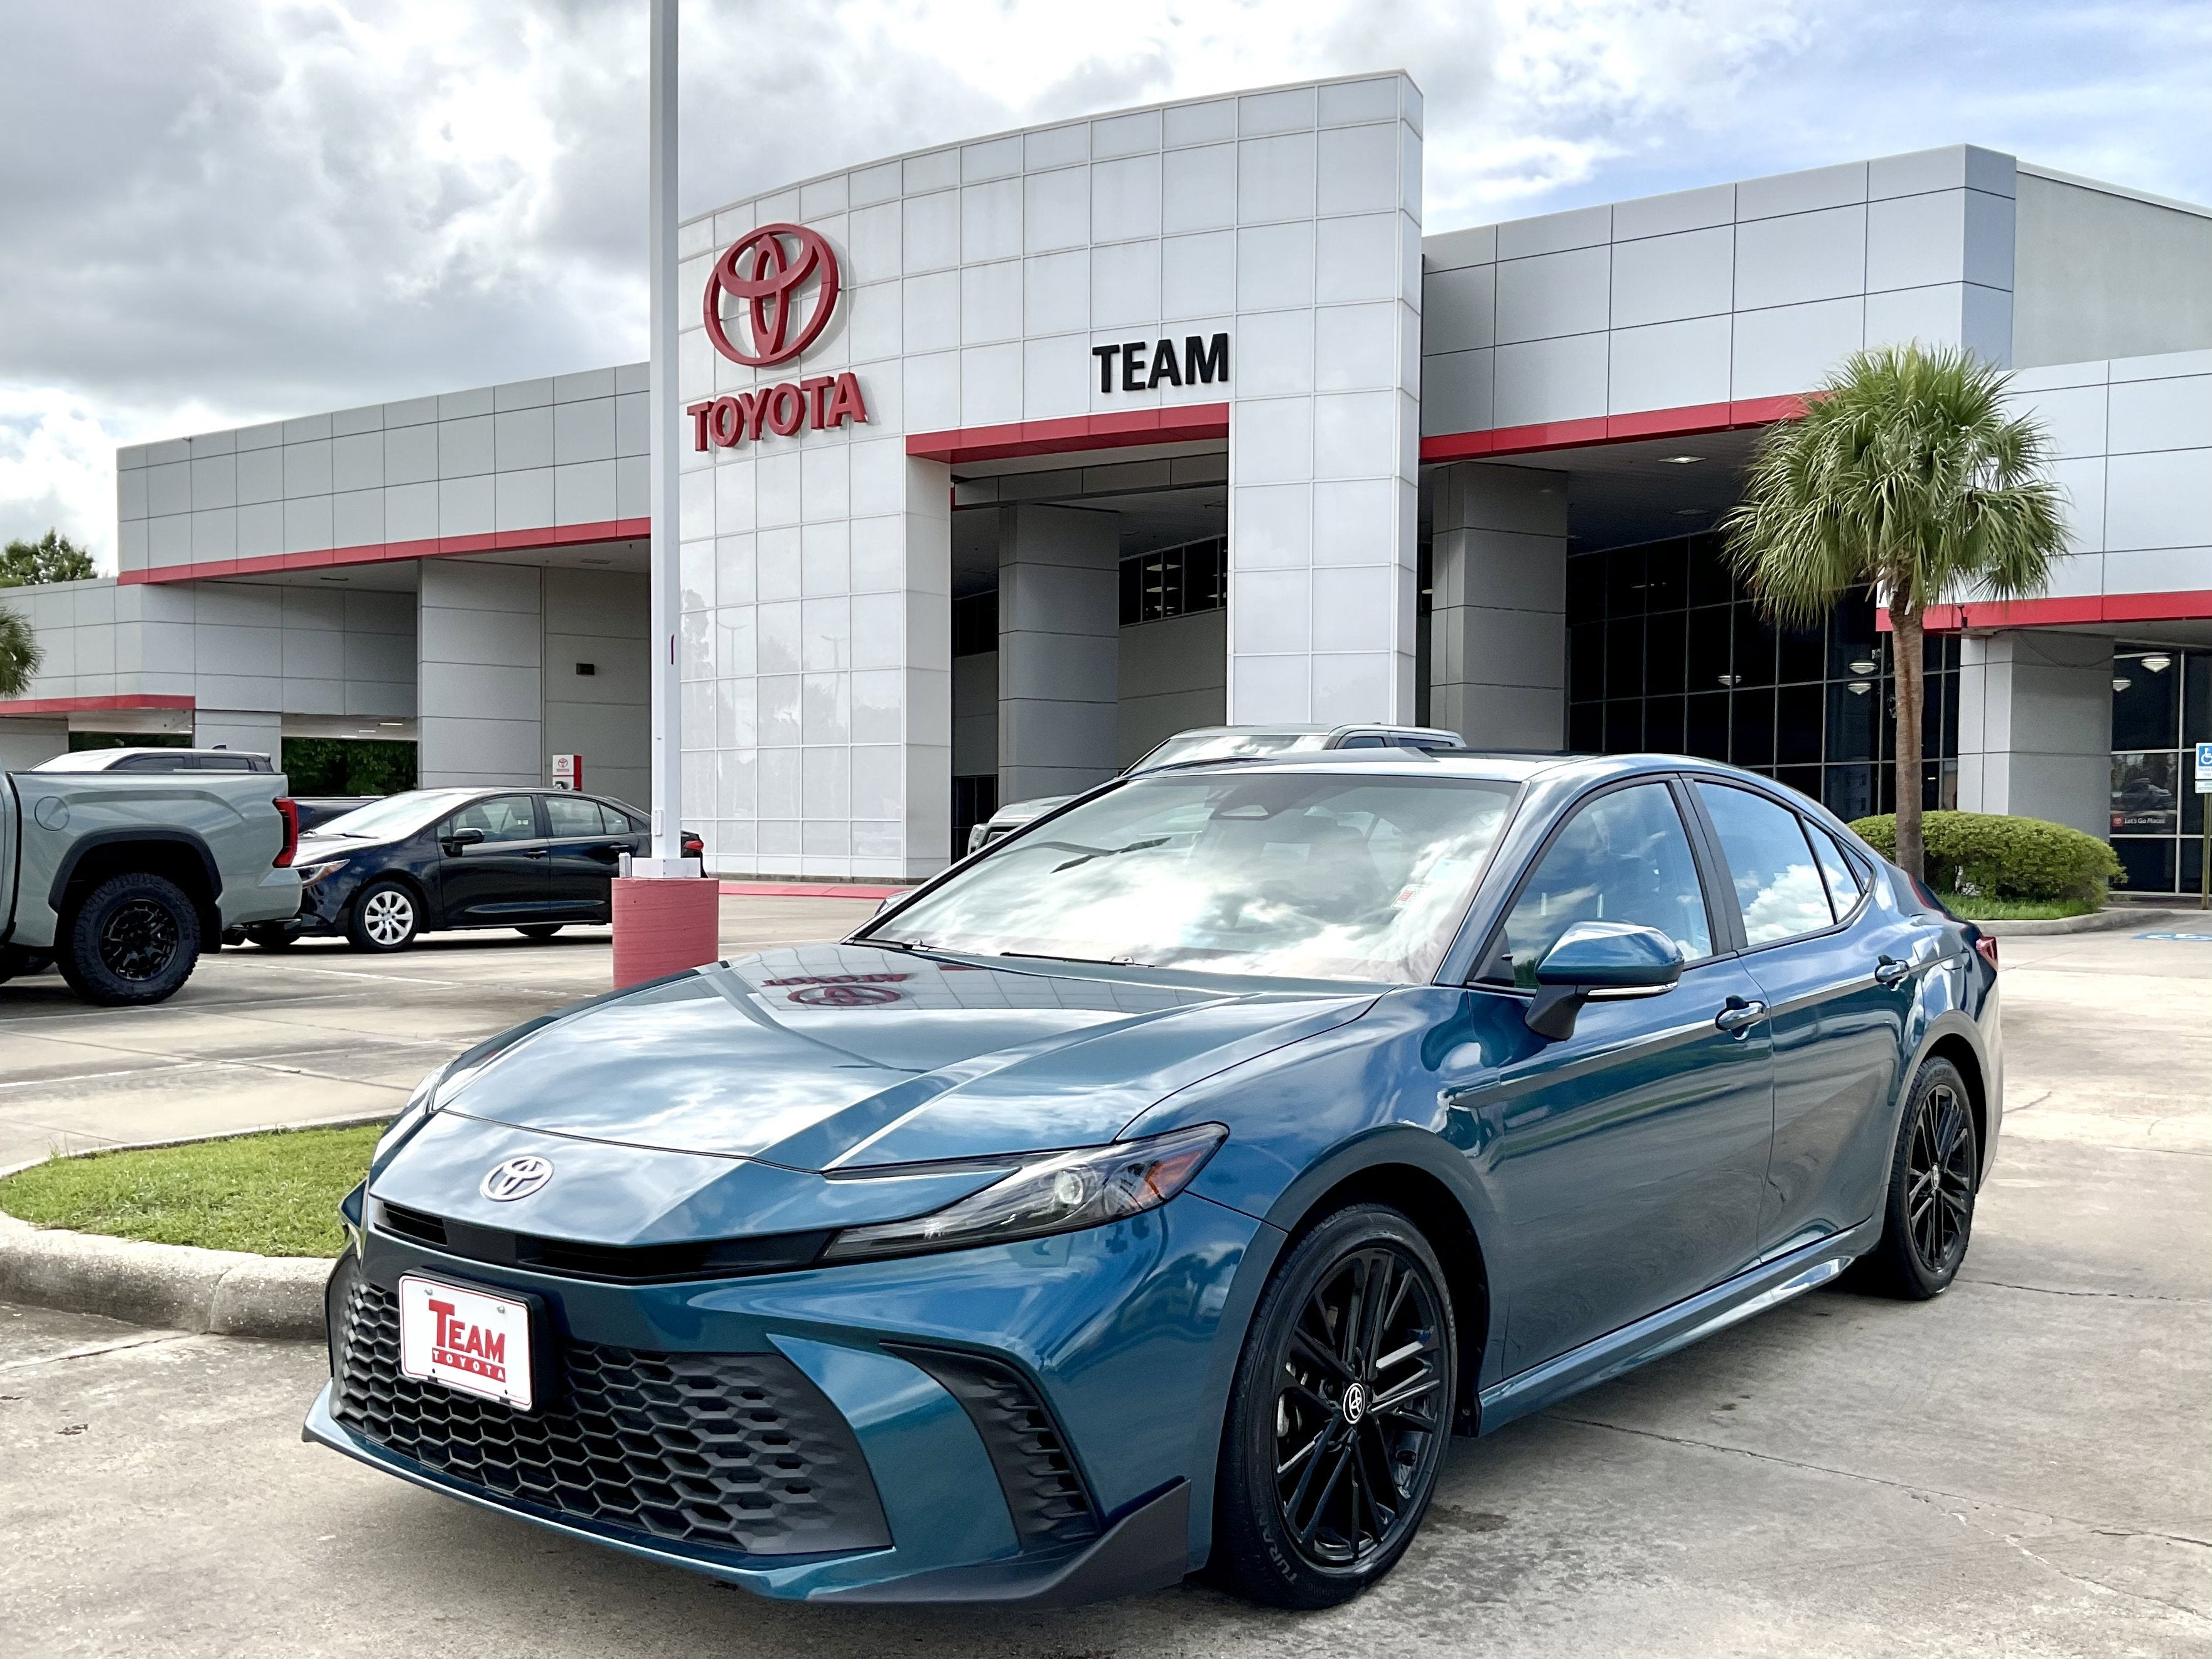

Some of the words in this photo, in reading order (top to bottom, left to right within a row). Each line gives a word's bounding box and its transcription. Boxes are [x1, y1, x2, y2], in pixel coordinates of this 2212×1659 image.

[1092, 333, 1228, 393] TEAM
[687, 372, 868, 452] TOYOTA
[429, 1299, 505, 1364] TEAM
[432, 1350, 505, 1380] TOYOTA
